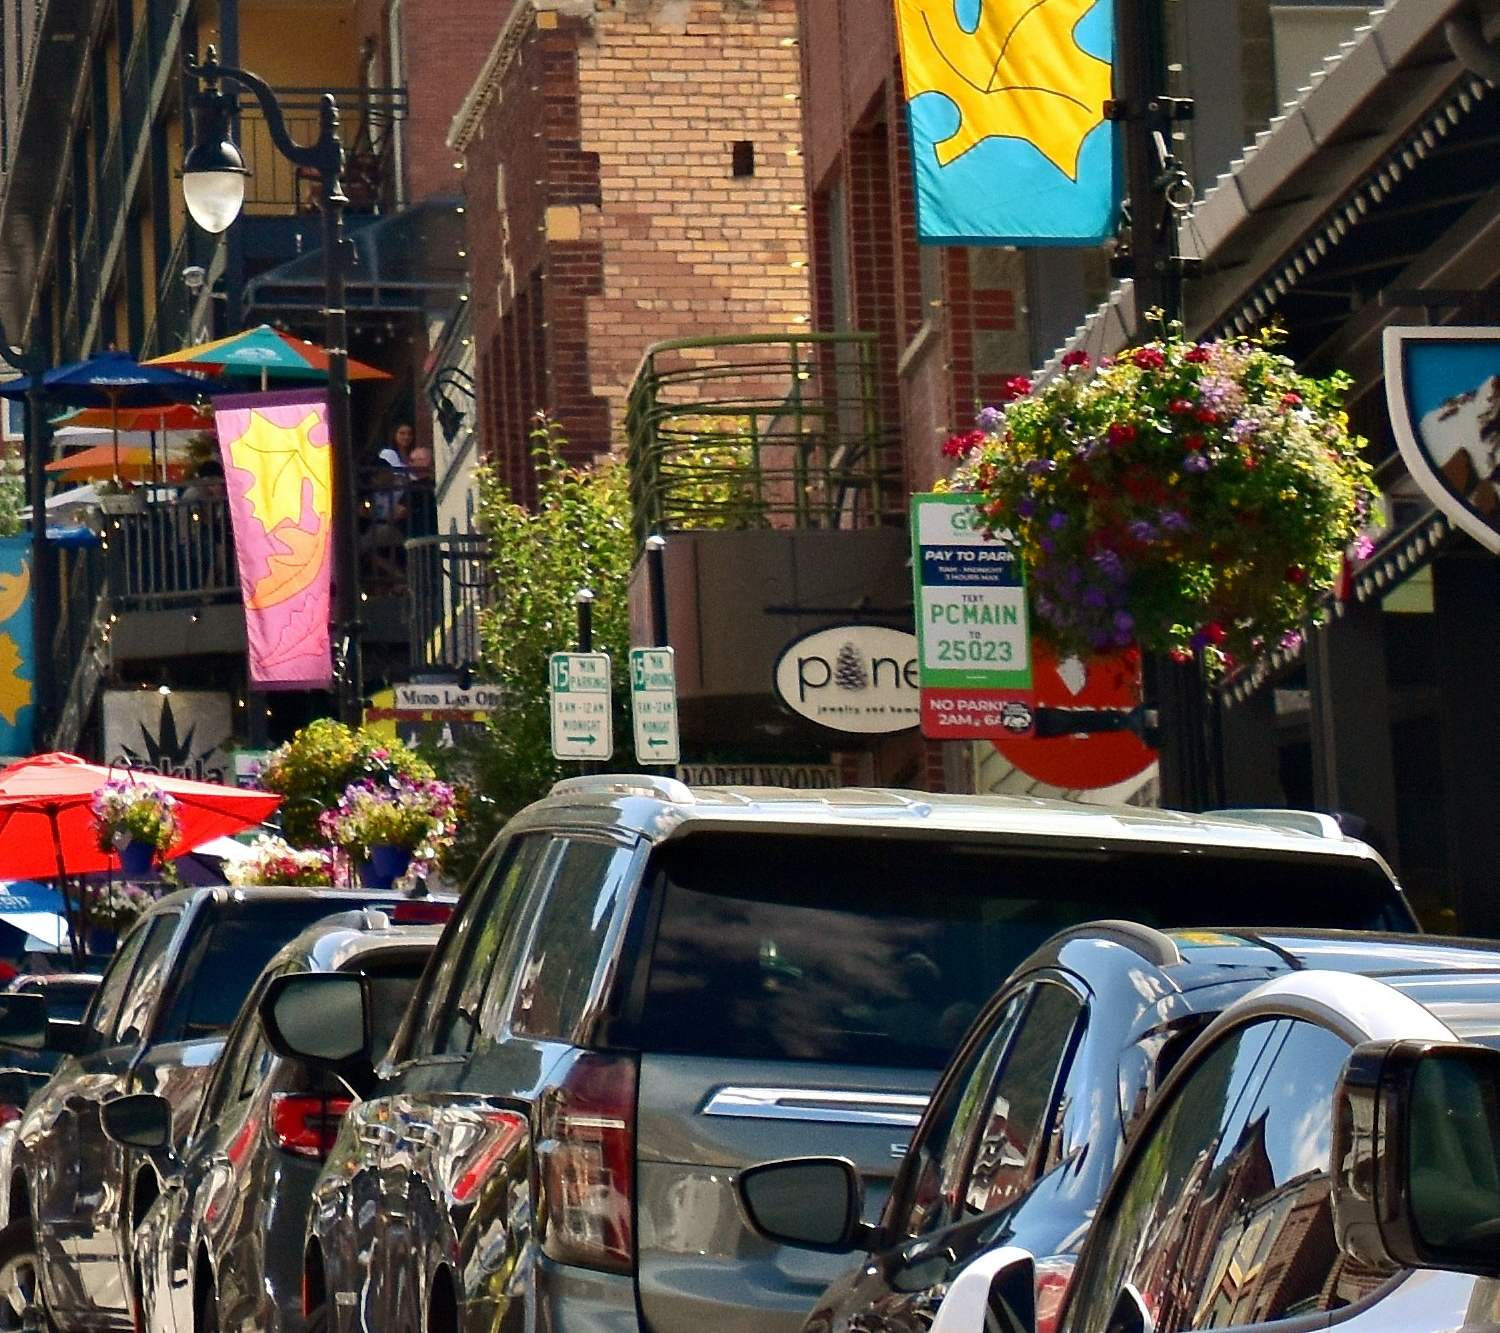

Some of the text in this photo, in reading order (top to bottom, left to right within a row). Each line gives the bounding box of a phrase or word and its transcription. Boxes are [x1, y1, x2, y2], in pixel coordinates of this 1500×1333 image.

[925, 550, 953, 561] PAY
[956, 551, 975, 561] TO
[931, 604, 1018, 625] PCMAIN
[938, 640, 1012, 661] 25023
[553, 661, 569, 687] 15
[865, 704, 885, 714] and
[930, 699, 1006, 711] NO PARKI
[939, 714, 972, 726] 2AM
[984, 714, 1004, 726] 6A
